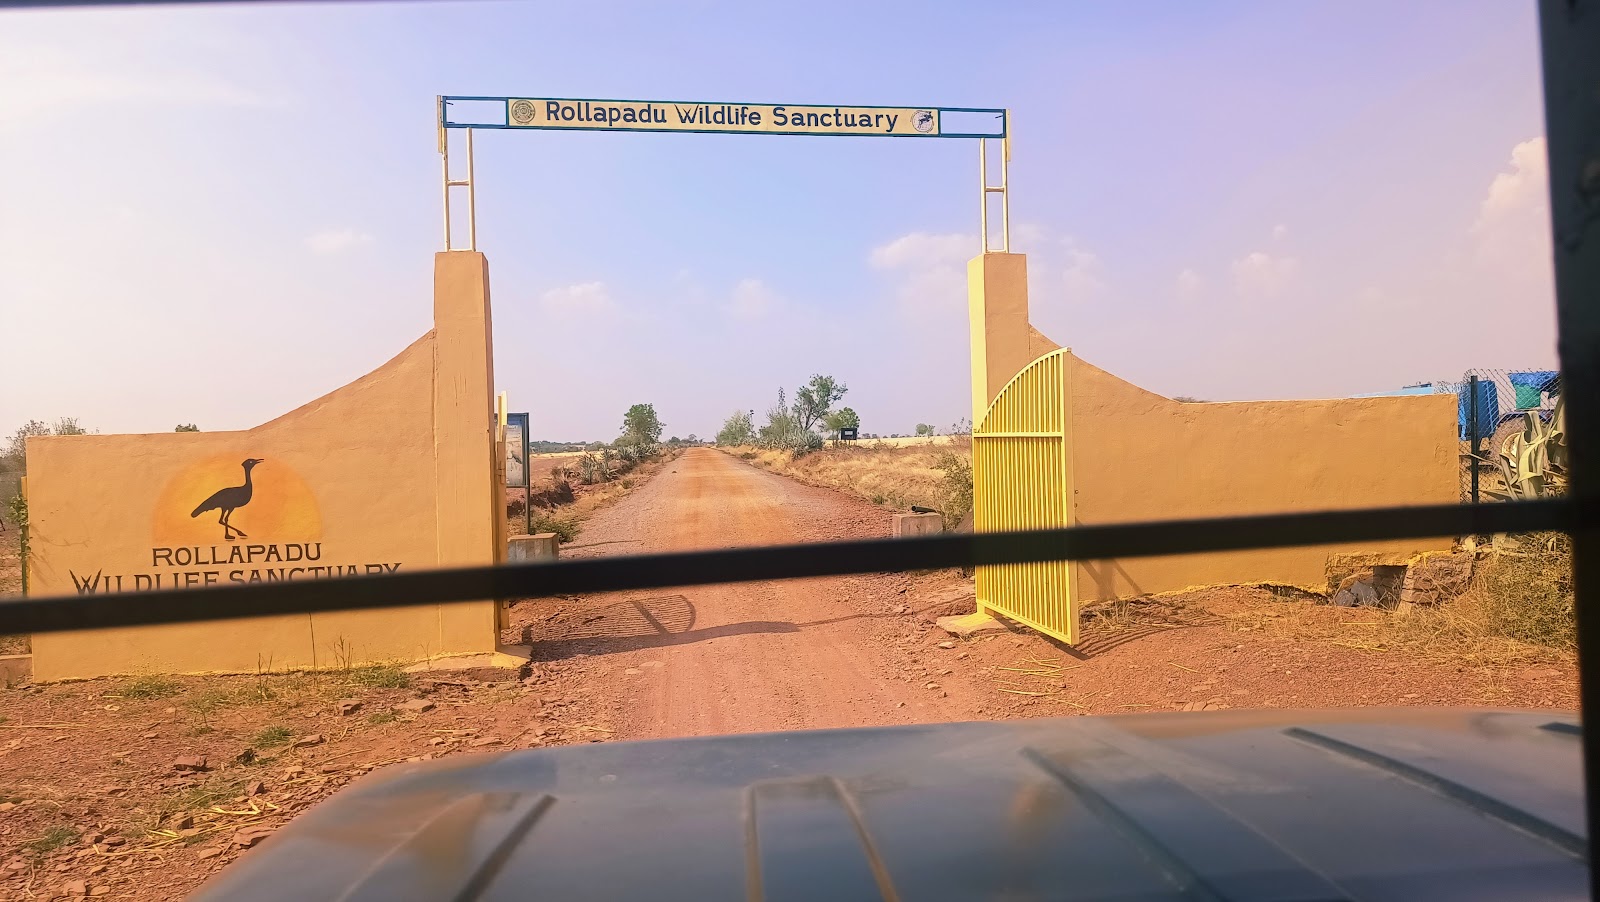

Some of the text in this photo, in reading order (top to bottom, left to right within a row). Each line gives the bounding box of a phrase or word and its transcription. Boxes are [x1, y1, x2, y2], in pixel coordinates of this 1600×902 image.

[546, 100, 898, 132] Rollapadu Wildlife Sanctuary
[152, 543, 322, 567] ROLLAPADU
